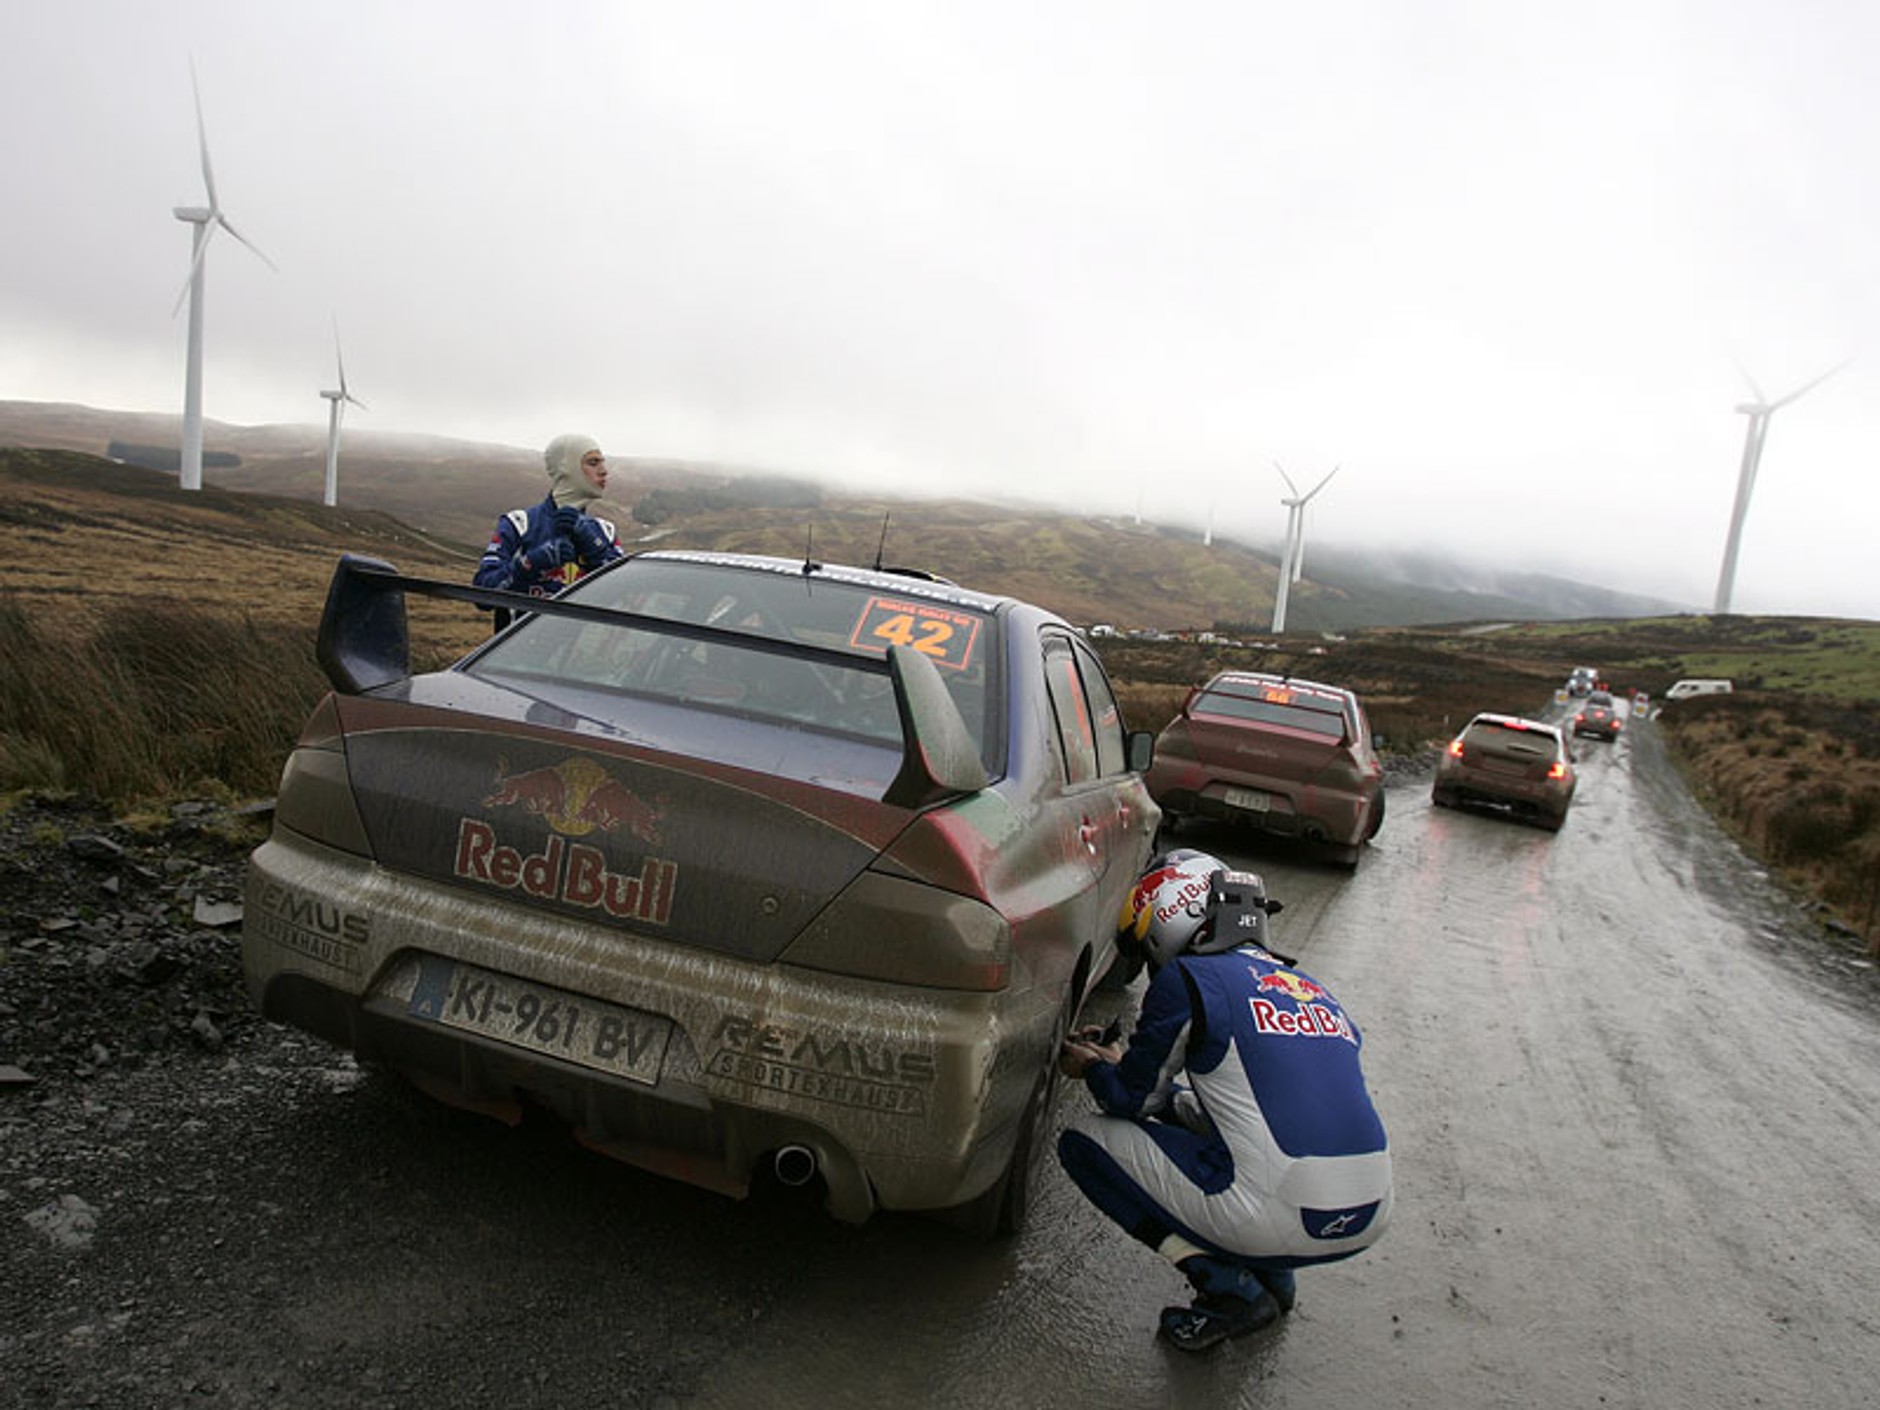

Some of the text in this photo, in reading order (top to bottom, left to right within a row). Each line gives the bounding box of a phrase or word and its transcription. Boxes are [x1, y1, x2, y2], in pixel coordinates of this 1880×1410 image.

[873, 614, 953, 657] 42
[454, 817, 678, 926] Red Bull
[1156, 890, 1191, 923] Red
[418, 1000, 432, 1014] A
[1248, 997, 1322, 1036] Red
[593, 1016, 656, 1068] BV
[711, 1014, 934, 1082] REMUS
